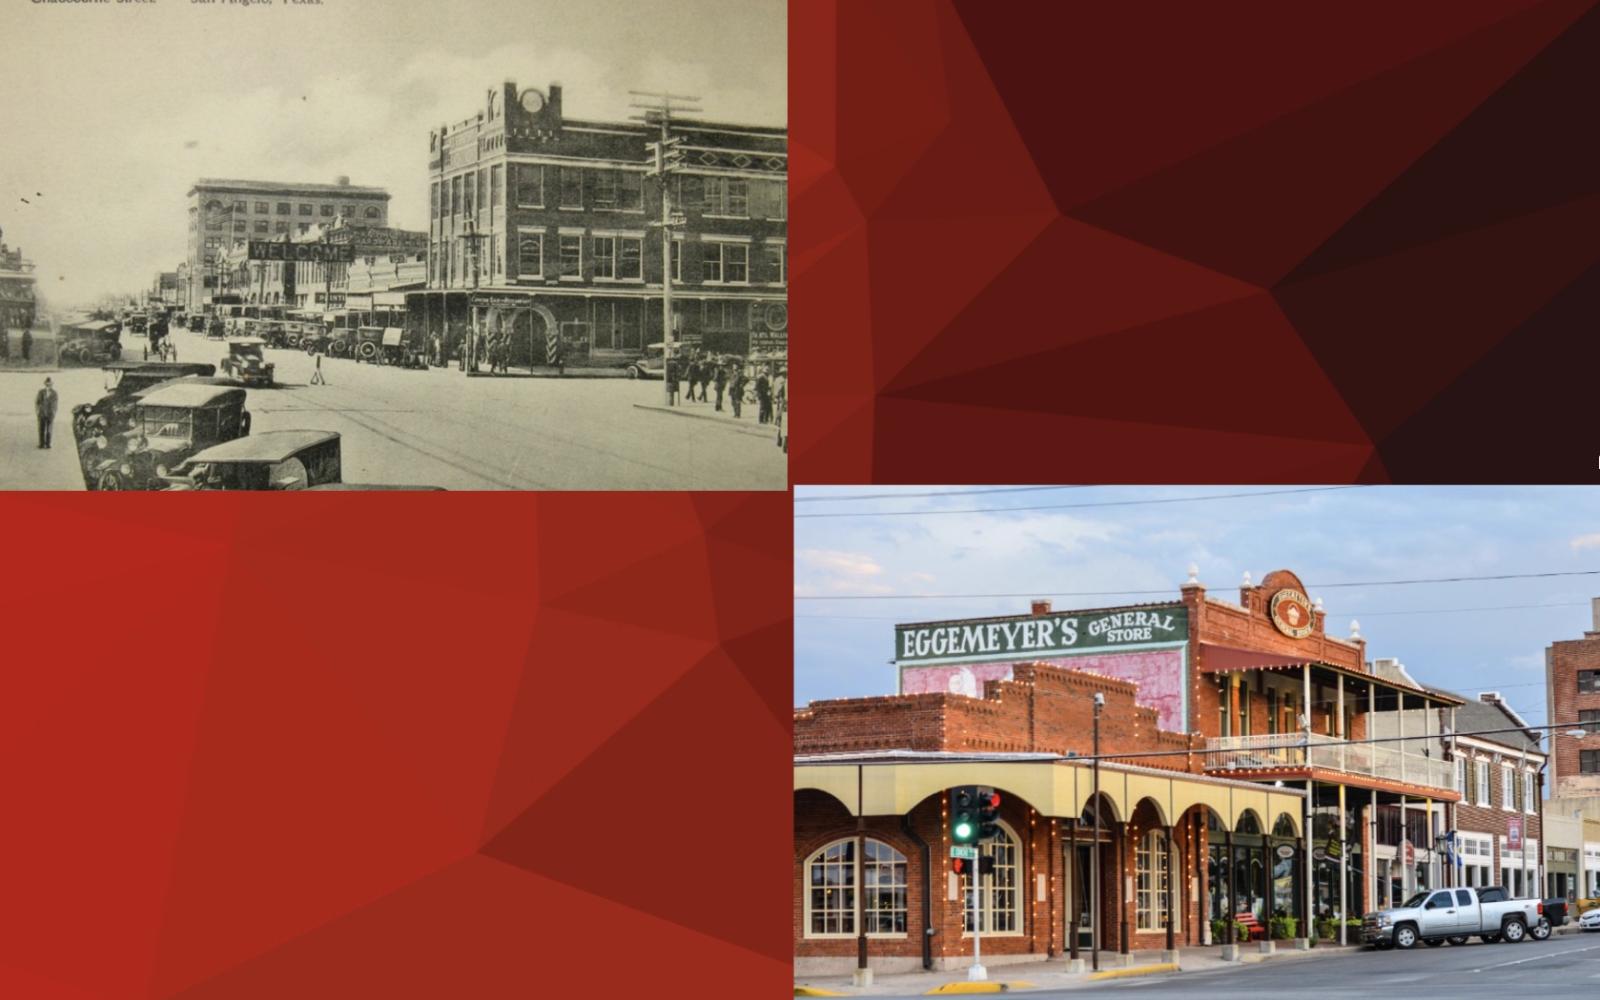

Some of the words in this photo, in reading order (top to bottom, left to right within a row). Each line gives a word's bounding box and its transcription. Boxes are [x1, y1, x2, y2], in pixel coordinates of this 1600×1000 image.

[252, 242, 353, 261] WELCOME
[902, 617, 1079, 658] EGGEMEYER'S
[1088, 611, 1176, 637] GENERAL
[1107, 626, 1153, 643] STORE
